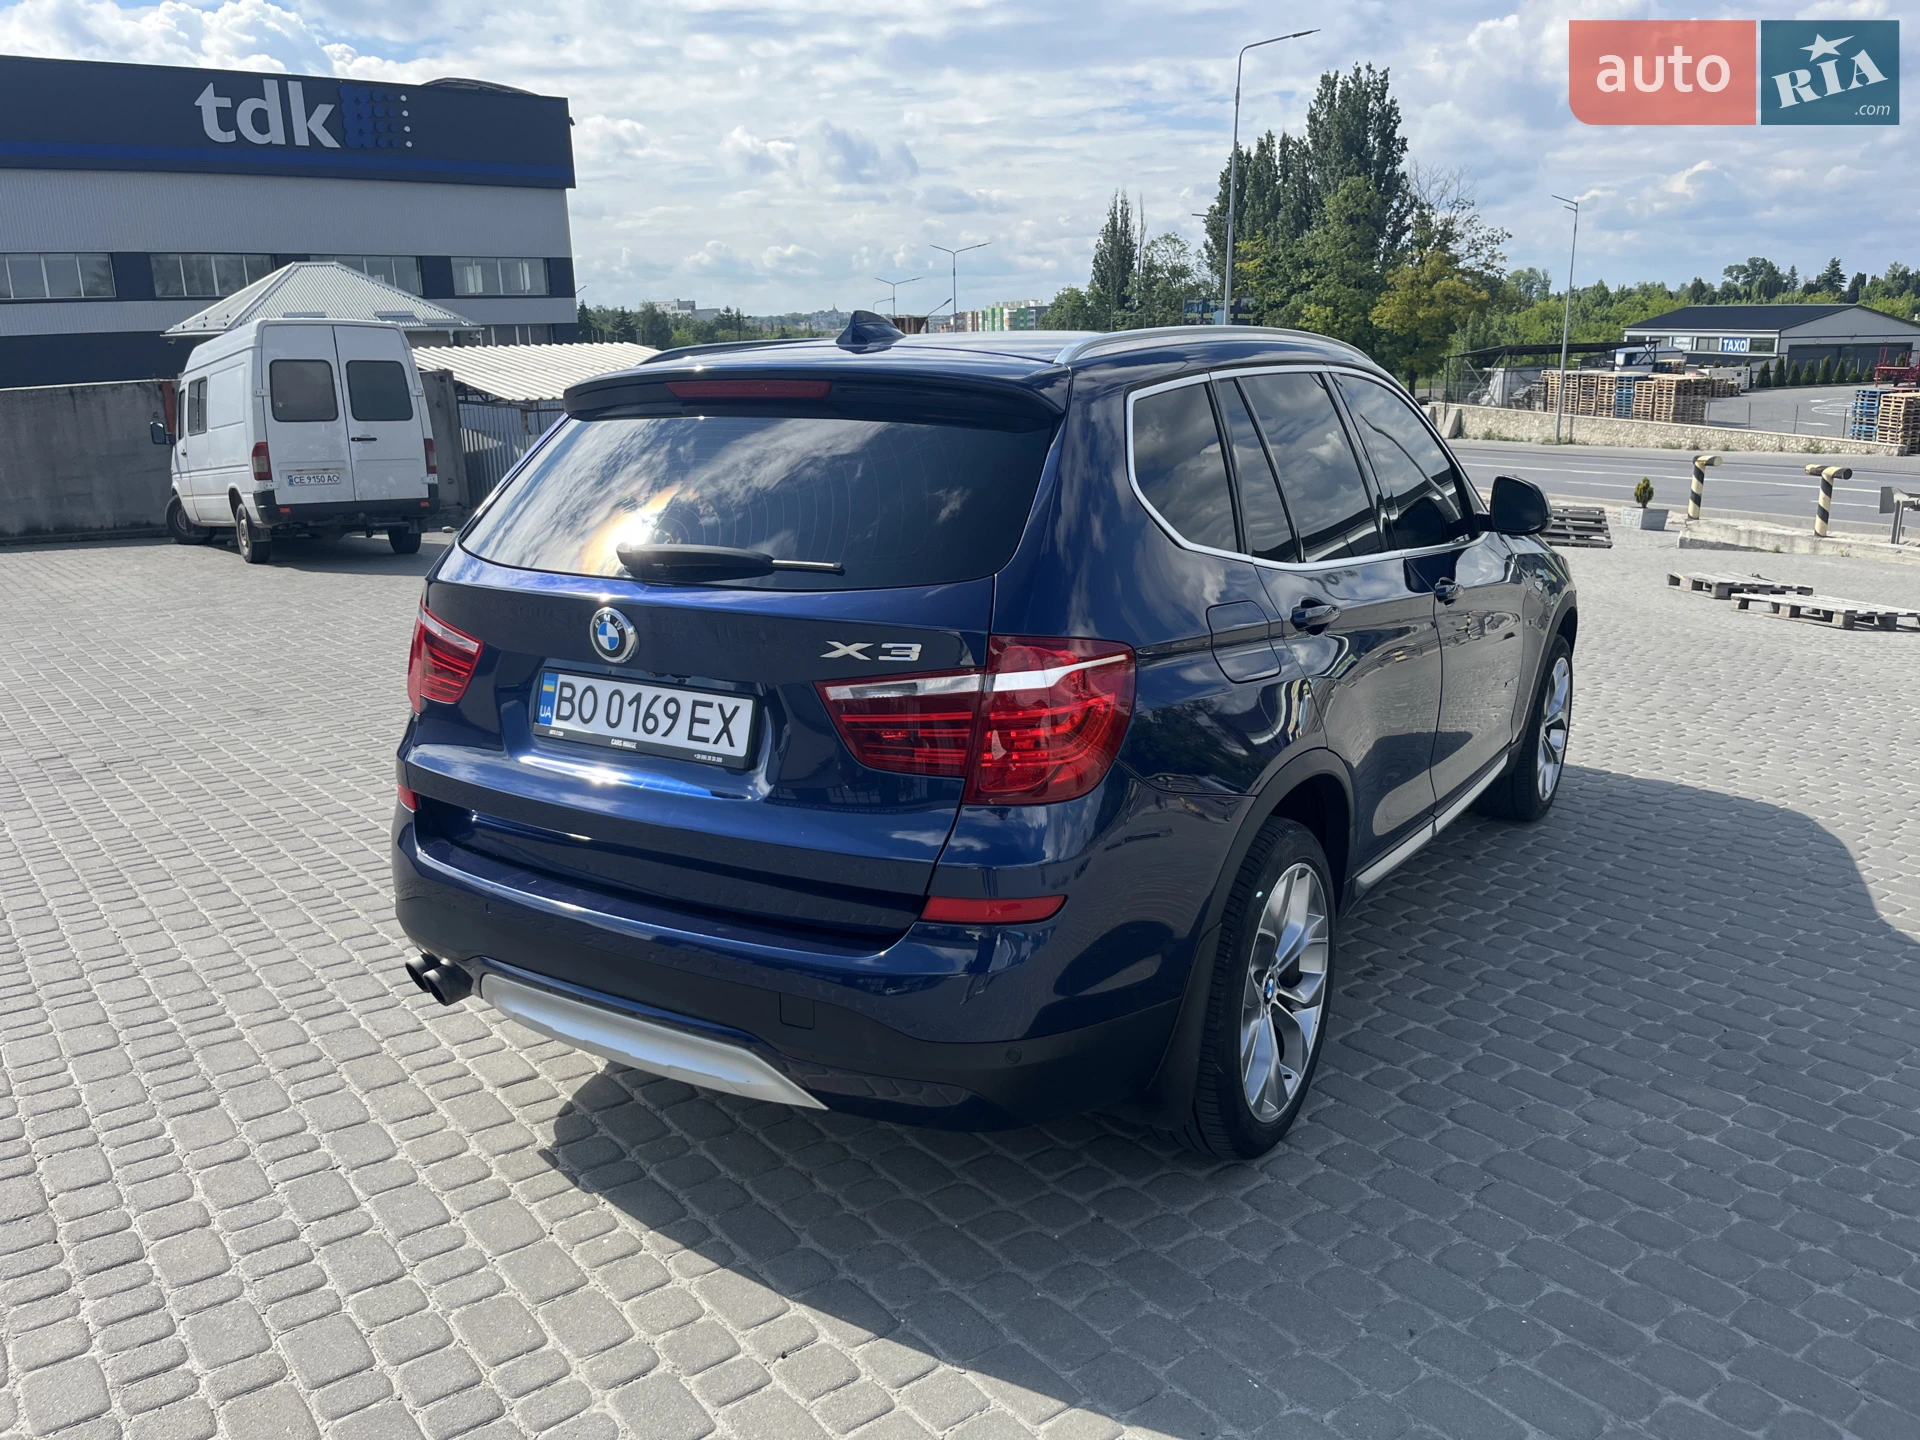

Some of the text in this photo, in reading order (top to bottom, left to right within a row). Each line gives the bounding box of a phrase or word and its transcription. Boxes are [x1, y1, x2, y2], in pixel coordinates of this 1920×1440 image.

[194, 78, 341, 148] tdk
[1723, 339, 1746, 351] TAXO
[294, 476, 305, 484] CE
[307, 475, 326, 483] 9150
[594, 613, 623, 630] BMW
[820, 640, 922, 662] X3
[540, 705, 552, 718] UA
[555, 681, 740, 747] BO 0169 EX
